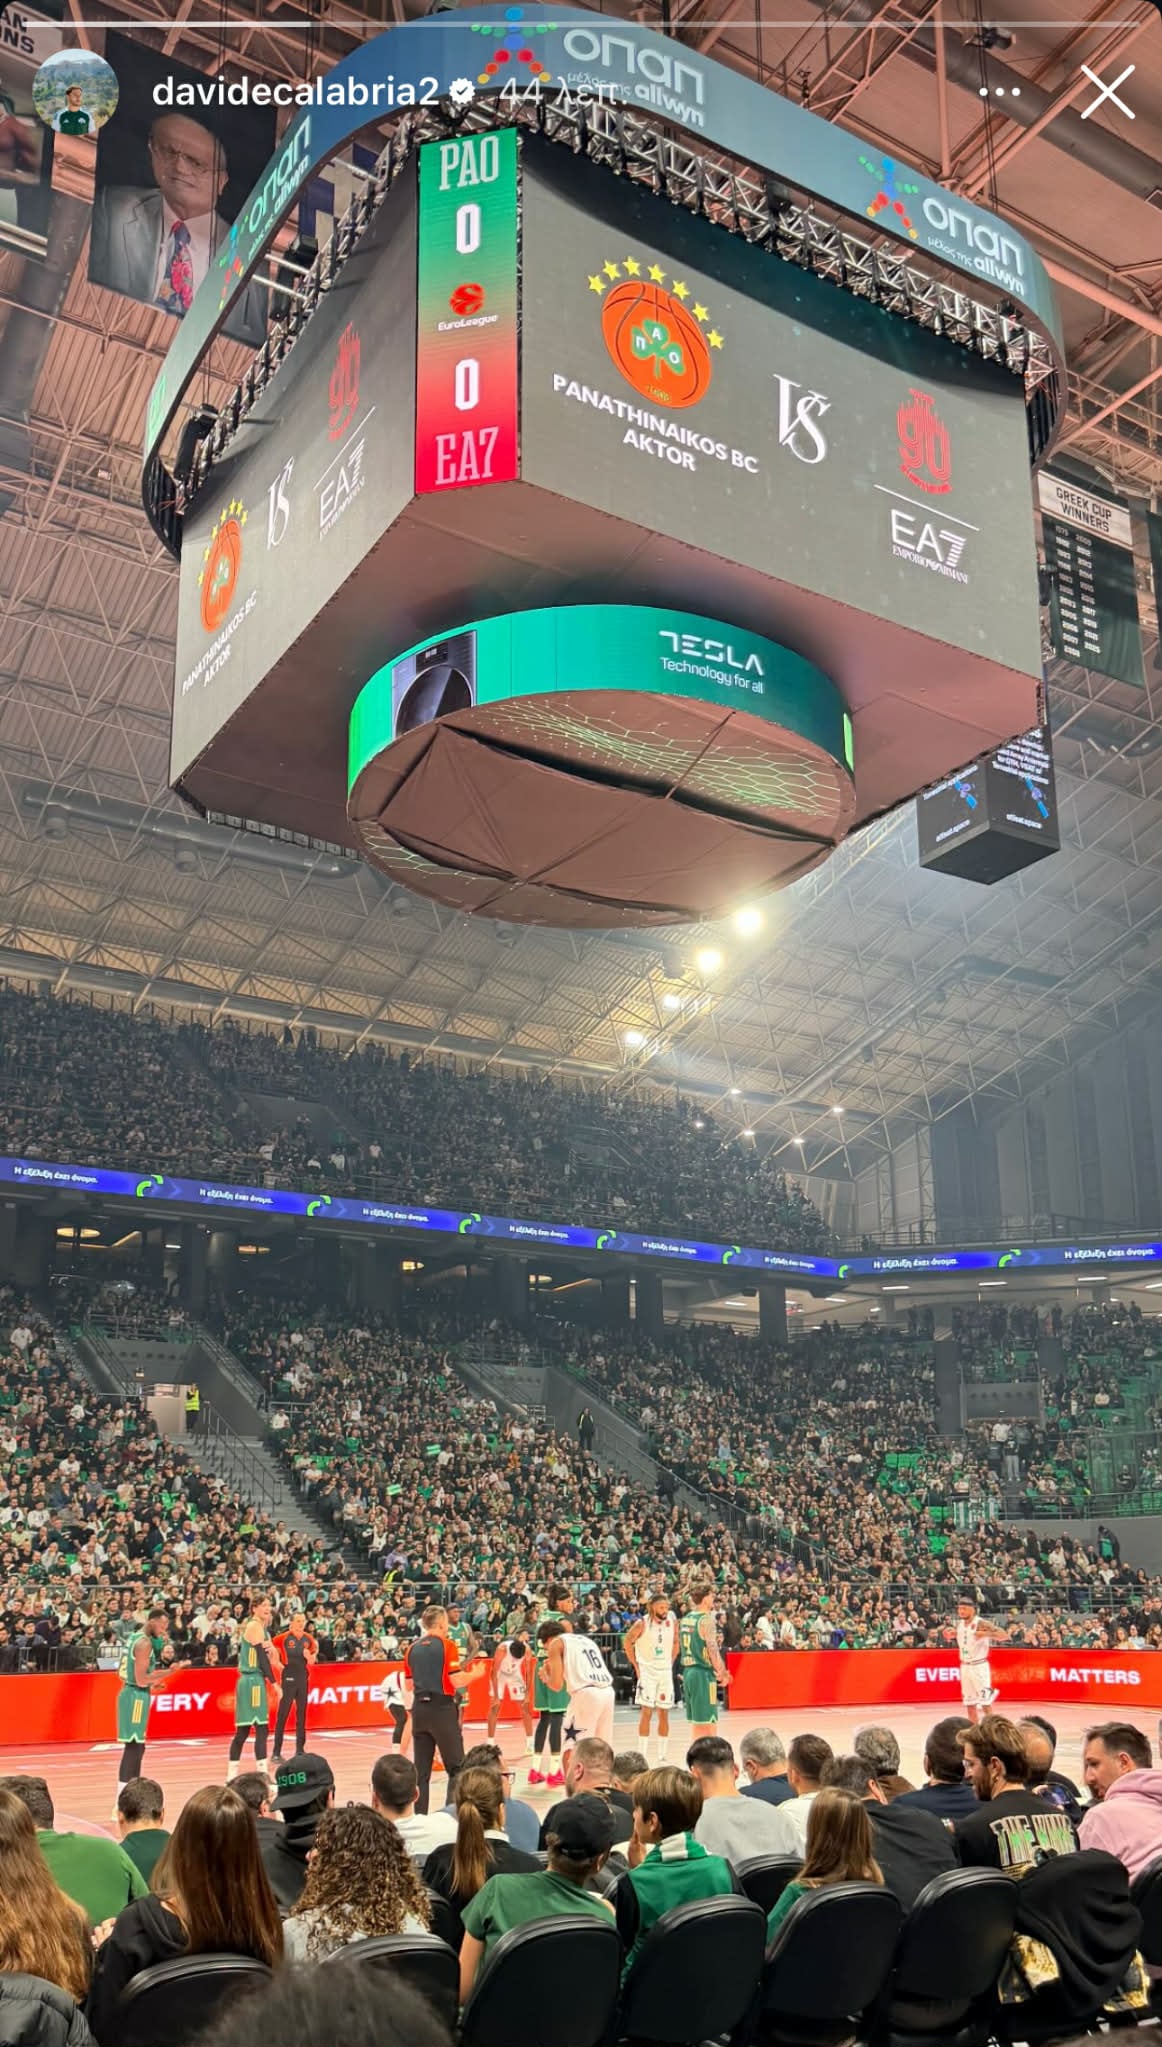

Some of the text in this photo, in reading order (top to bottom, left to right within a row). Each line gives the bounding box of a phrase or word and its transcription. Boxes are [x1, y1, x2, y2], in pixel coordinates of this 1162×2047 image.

[0, 26, 34, 54] NS
[633, 83, 705, 129] allwyn
[438, 135, 499, 191] PAO
[455, 203, 482, 255] 0
[973, 256, 1025, 297] allwyn
[438, 314, 499, 332] EuroLeague
[454, 358, 480, 411] 0
[553, 373, 760, 474] PANATHINAIKOS BC
[772, 373, 832, 464] VS
[896, 400, 952, 482] 90
[435, 427, 500, 486] EA7
[623, 429, 697, 472] AKTOR
[1056, 487, 1112, 520] GREEK CUP
[1060, 502, 1110, 533] WINNERS
[891, 509, 967, 568] EA7
[203, 643, 232, 688] AKTOR
[659, 630, 765, 676] TESLA
[659, 657, 764, 695] Technology for all
[582, 1648, 602, 1669] 16
[914, 1667, 961, 1682] EVER
[1050, 1667, 1141, 1685] MATTERS
